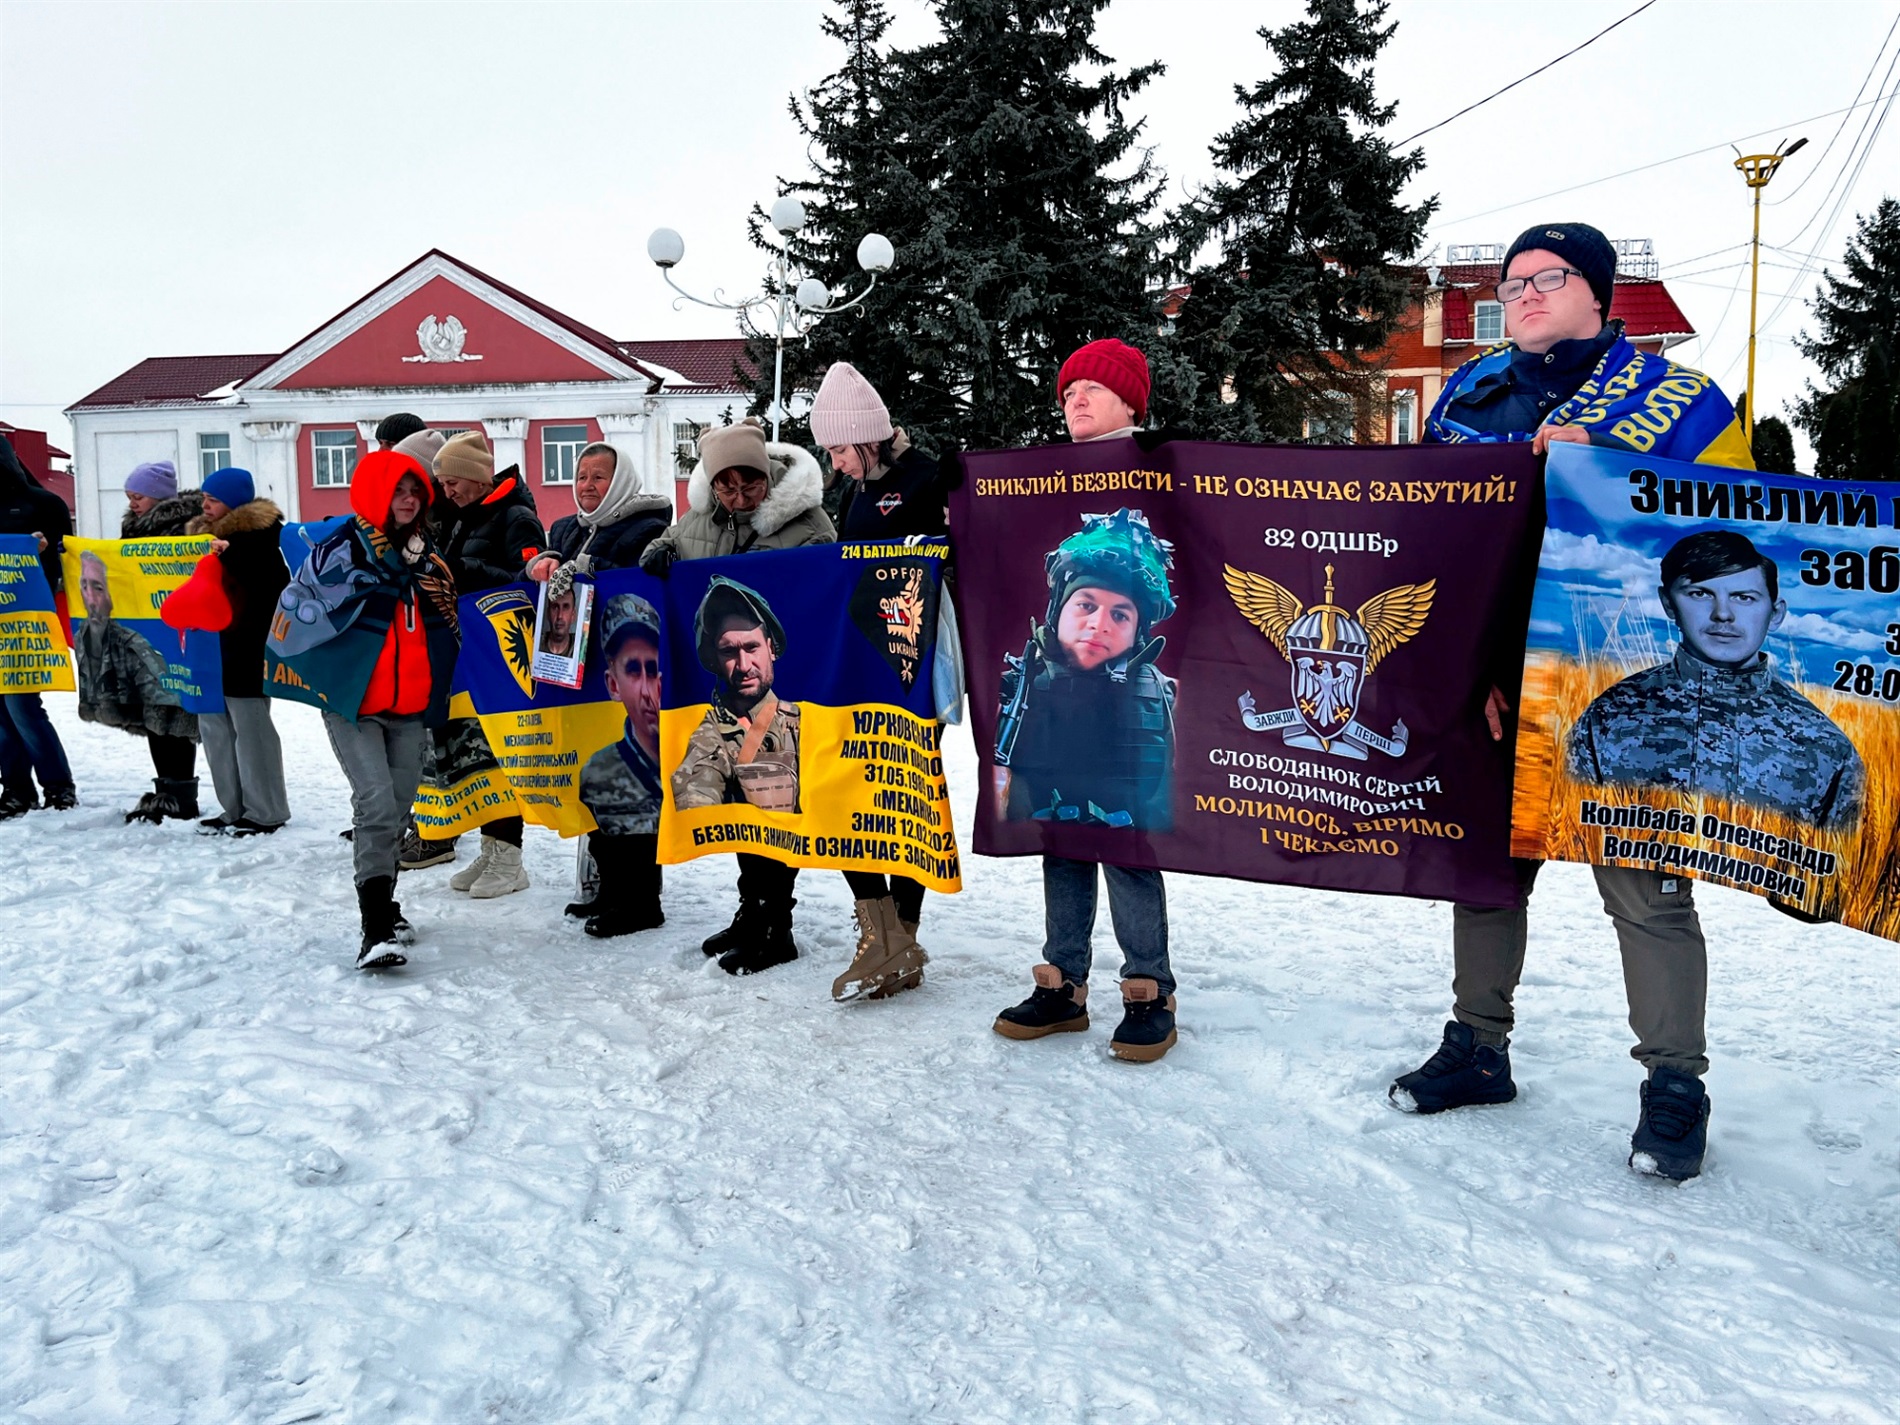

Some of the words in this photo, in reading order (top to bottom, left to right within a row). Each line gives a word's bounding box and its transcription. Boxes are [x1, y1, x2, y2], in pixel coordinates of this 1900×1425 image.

[976, 470, 1067, 496] ЗНИКЛИЙ
[1071, 469, 1173, 493] БЕЗВІСТИ
[1193, 475, 1228, 497] НЕ
[1234, 477, 1362, 502] ОЗНАЧАЄ
[1368, 474, 1517, 504] ЗАБУТИЙ!
[1628, 469, 1878, 529] Зниклий
[841, 545, 861, 559] 214
[1264, 528, 1296, 549] 82
[1301, 530, 1399, 558] ОДШБр
[875, 567, 924, 581] OPFOR
[1, 620, 51, 635] ОКРЕМА
[3, 671, 53, 686] СИСТЕМ
[1254, 711, 1297, 728] ЗАВЖДИ
[840, 740, 908, 764] АНАТОЛІЙ
[1354, 726, 1391, 751] ПЕРШІ
[1209, 749, 1361, 788] СЛОБОДЯНЮК
[1365, 775, 1443, 798] СЕРГІЙ
[443, 776, 491, 807] Віталій
[1228, 773, 1426, 817] ВОЛОДИМИРОВИЧ
[851, 812, 896, 836] ЗНИК
[1352, 817, 1465, 841] ВІРИМО
[692, 823, 762, 846] БЕЗВІСТИ
[815, 836, 900, 862] ОЗНАЧАЄ
[1274, 829, 1400, 856] ЧЕКАЄМО
[1580, 800, 1697, 836] Колібаба
[1701, 813, 1836, 876] Олександр
[1603, 835, 1806, 900] Володимирович
